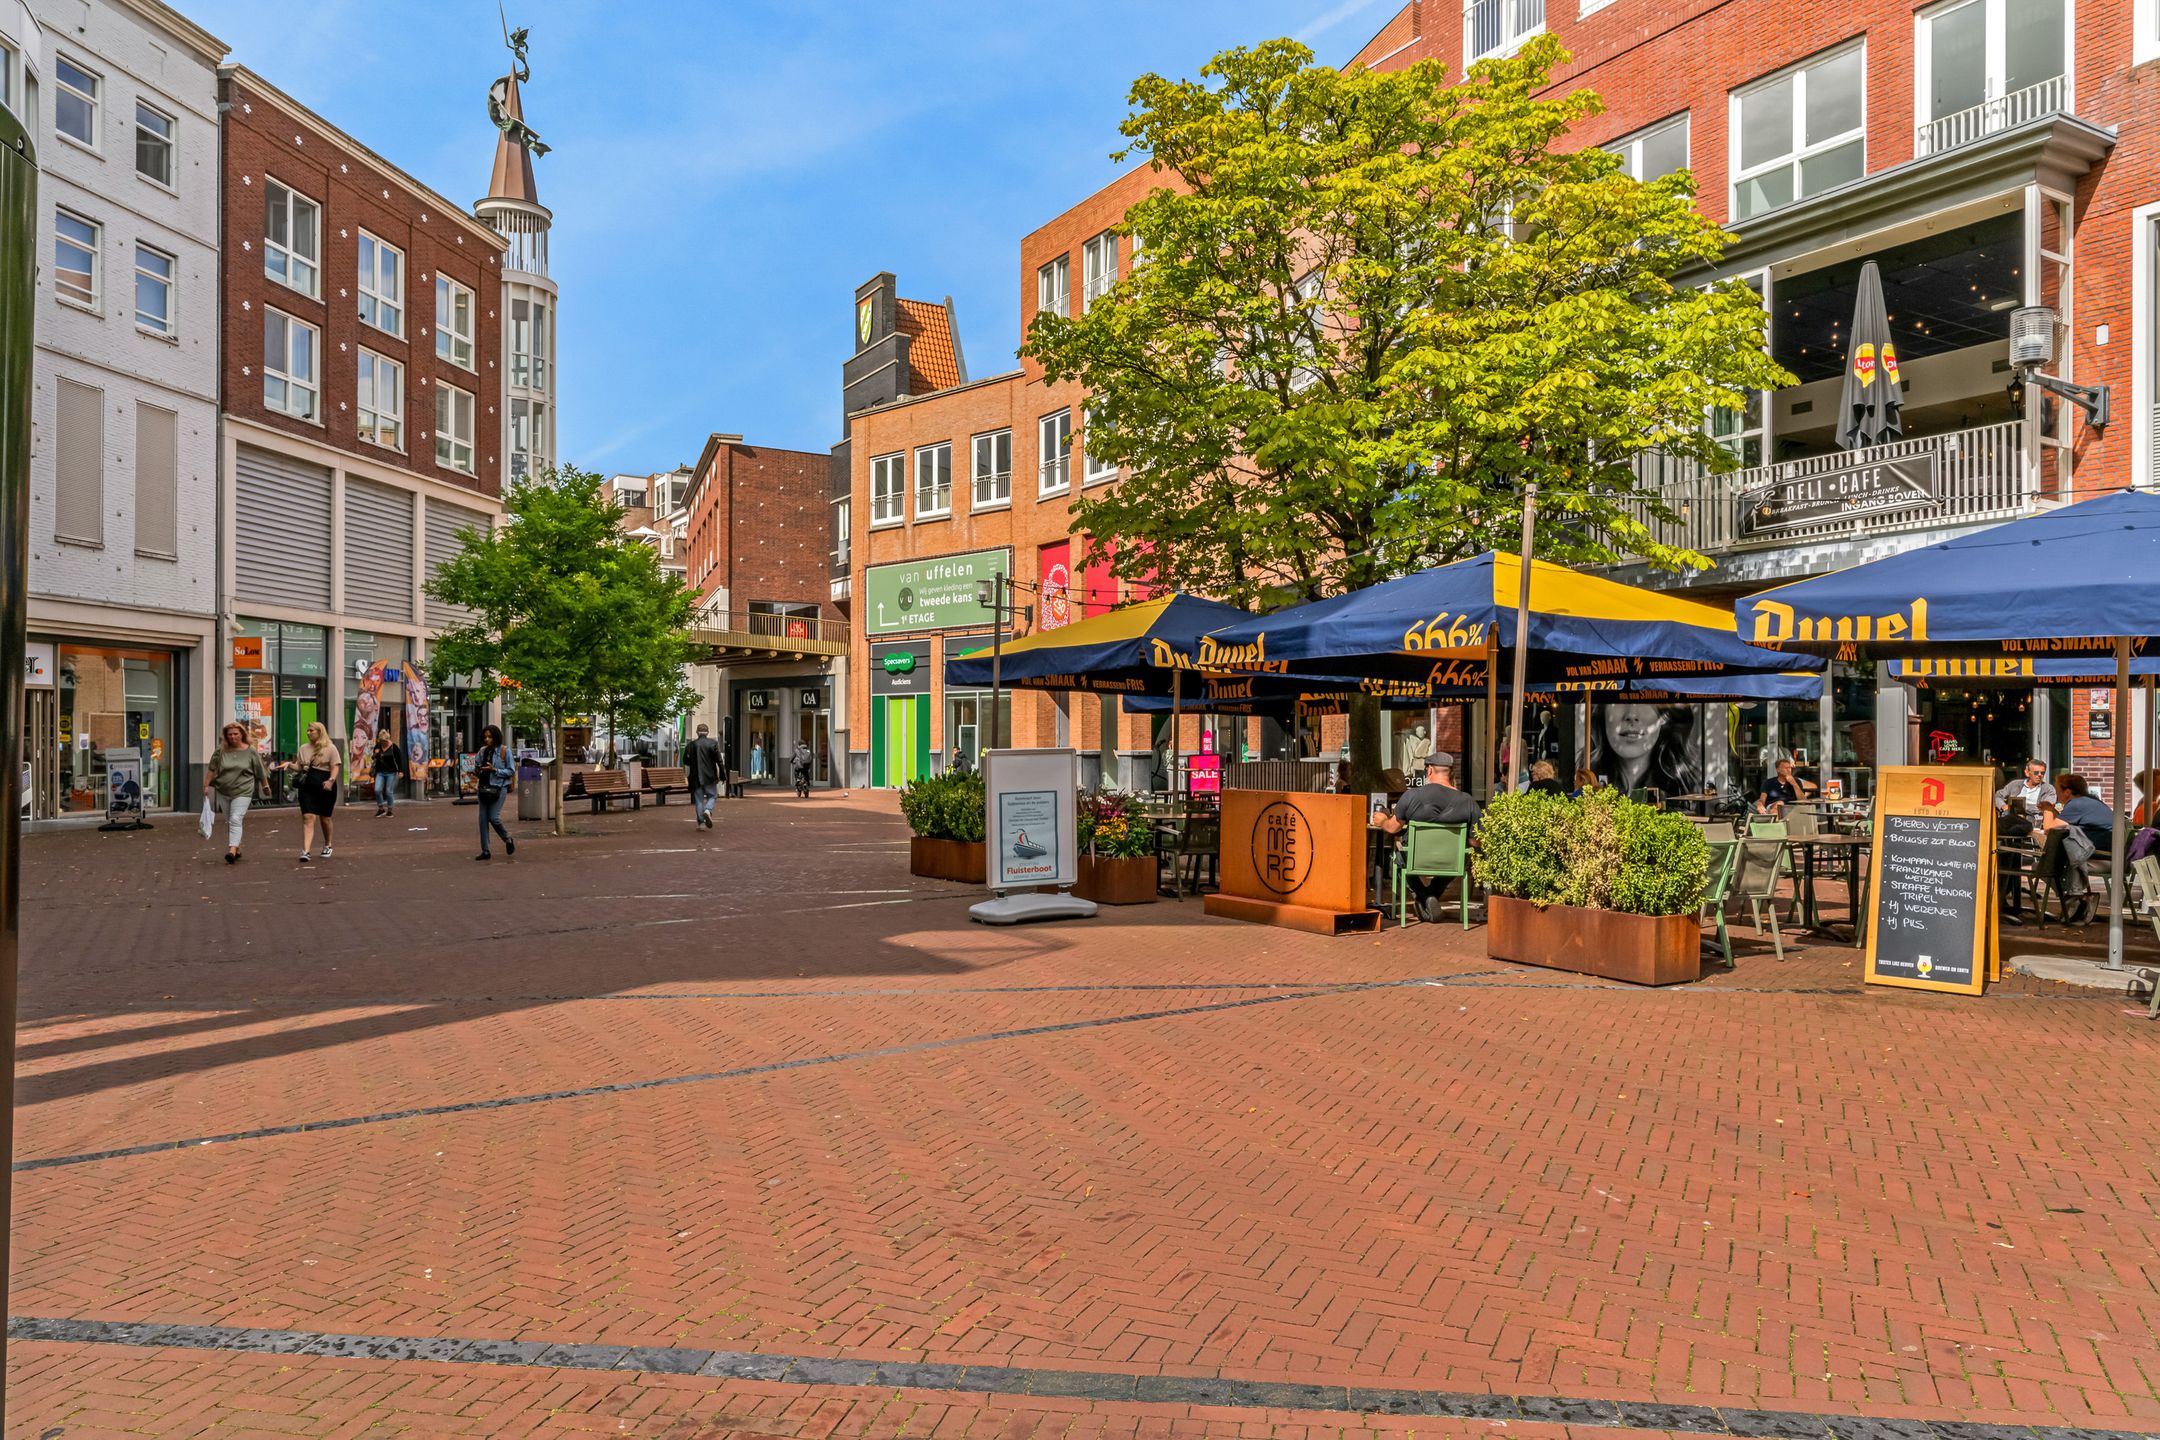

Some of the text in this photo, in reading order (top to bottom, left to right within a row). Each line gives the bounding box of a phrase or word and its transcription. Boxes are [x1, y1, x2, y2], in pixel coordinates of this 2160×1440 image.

[1840, 467, 1881, 494] CAFE
[899, 572, 920, 583] van
[926, 563, 973, 580] uffelen
[920, 592, 973, 607] tweede kans
[908, 612, 935, 624] ETAGE
[1751, 597, 1930, 641] Duvel
[1198, 632, 1265, 665] Duvel
[2002, 640, 2024, 651] VOL
[2026, 639, 2049, 651] VAN
[884, 657, 911, 667] Specsavers
[1566, 667, 1579, 677] VOL
[1579, 665, 1592, 676] VAN
[1591, 658, 1628, 675] SMAAK
[1650, 661, 1696, 672] VERRASSEND
[1045, 674, 1075, 687] SMAAK
[1126, 678, 1145, 691] FRIS
[1191, 770, 1218, 779] SALE
[1268, 813, 1297, 827] café
[1890, 817, 1930, 830] BIEREN
[1889, 833, 1976, 848] BRUGSE ZOT BLOND
[1890, 853, 1934, 866] KOMPAAN
[1007, 865, 1052, 874] Fluisterboot
[1899, 892, 1938, 904] TRIPEL
[1934, 886, 1973, 900] HENDRIK
